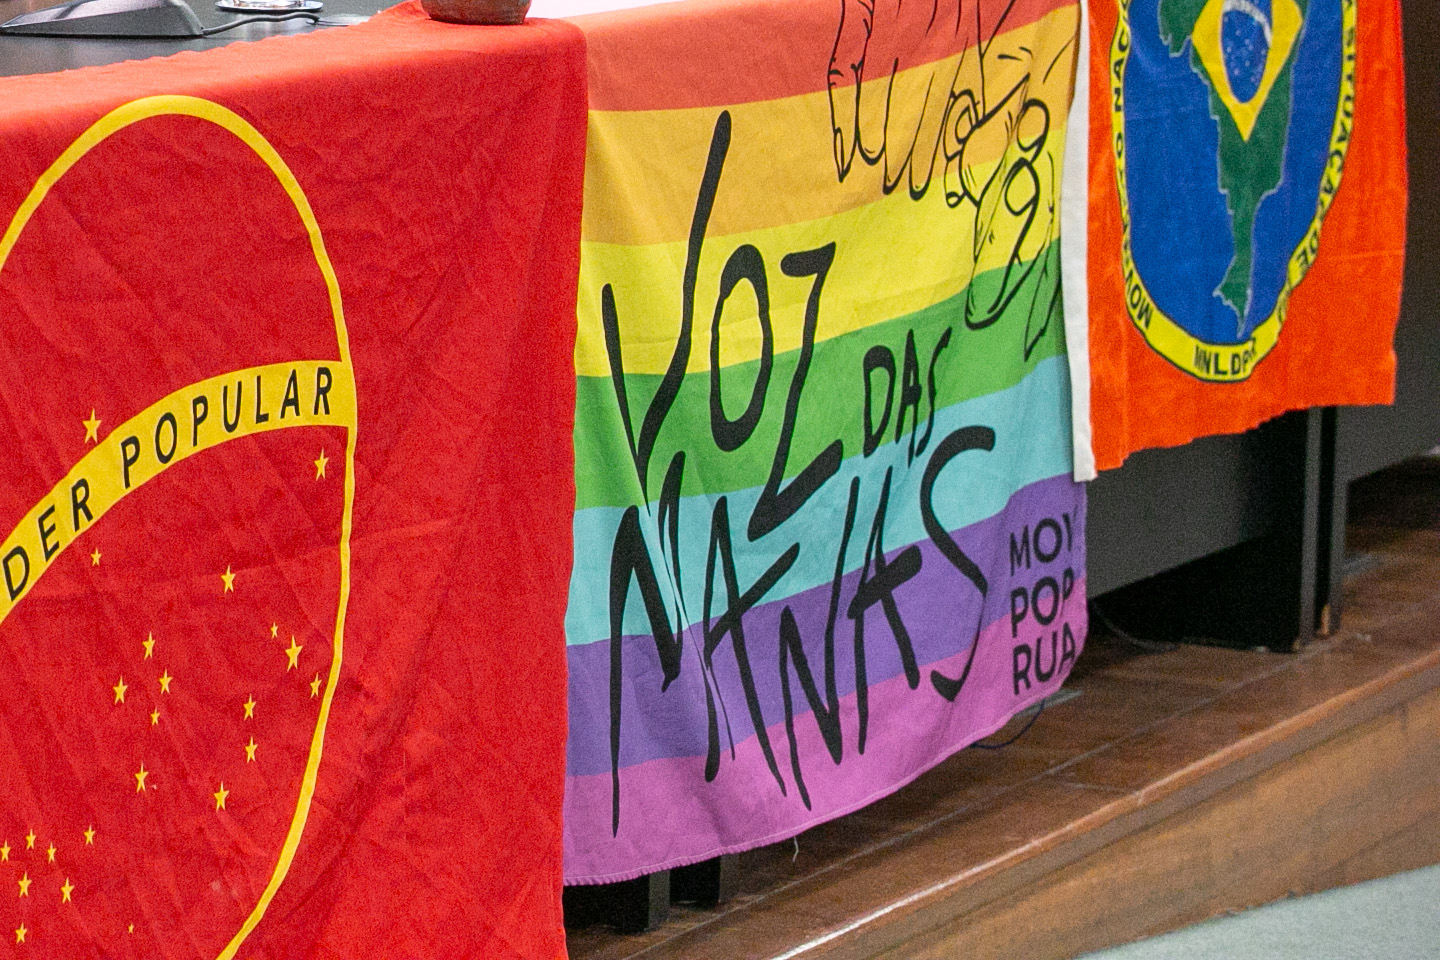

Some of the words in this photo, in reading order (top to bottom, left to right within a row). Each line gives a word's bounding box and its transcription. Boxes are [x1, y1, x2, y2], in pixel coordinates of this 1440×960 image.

[601, 110, 844, 542] VOZ
[862, 327, 953, 468] DAS
[120, 366, 333, 489] POPULAR
[609, 424, 997, 839] MANAS
[1011, 567, 1075, 639] POP
[1012, 622, 1077, 696] RUA
